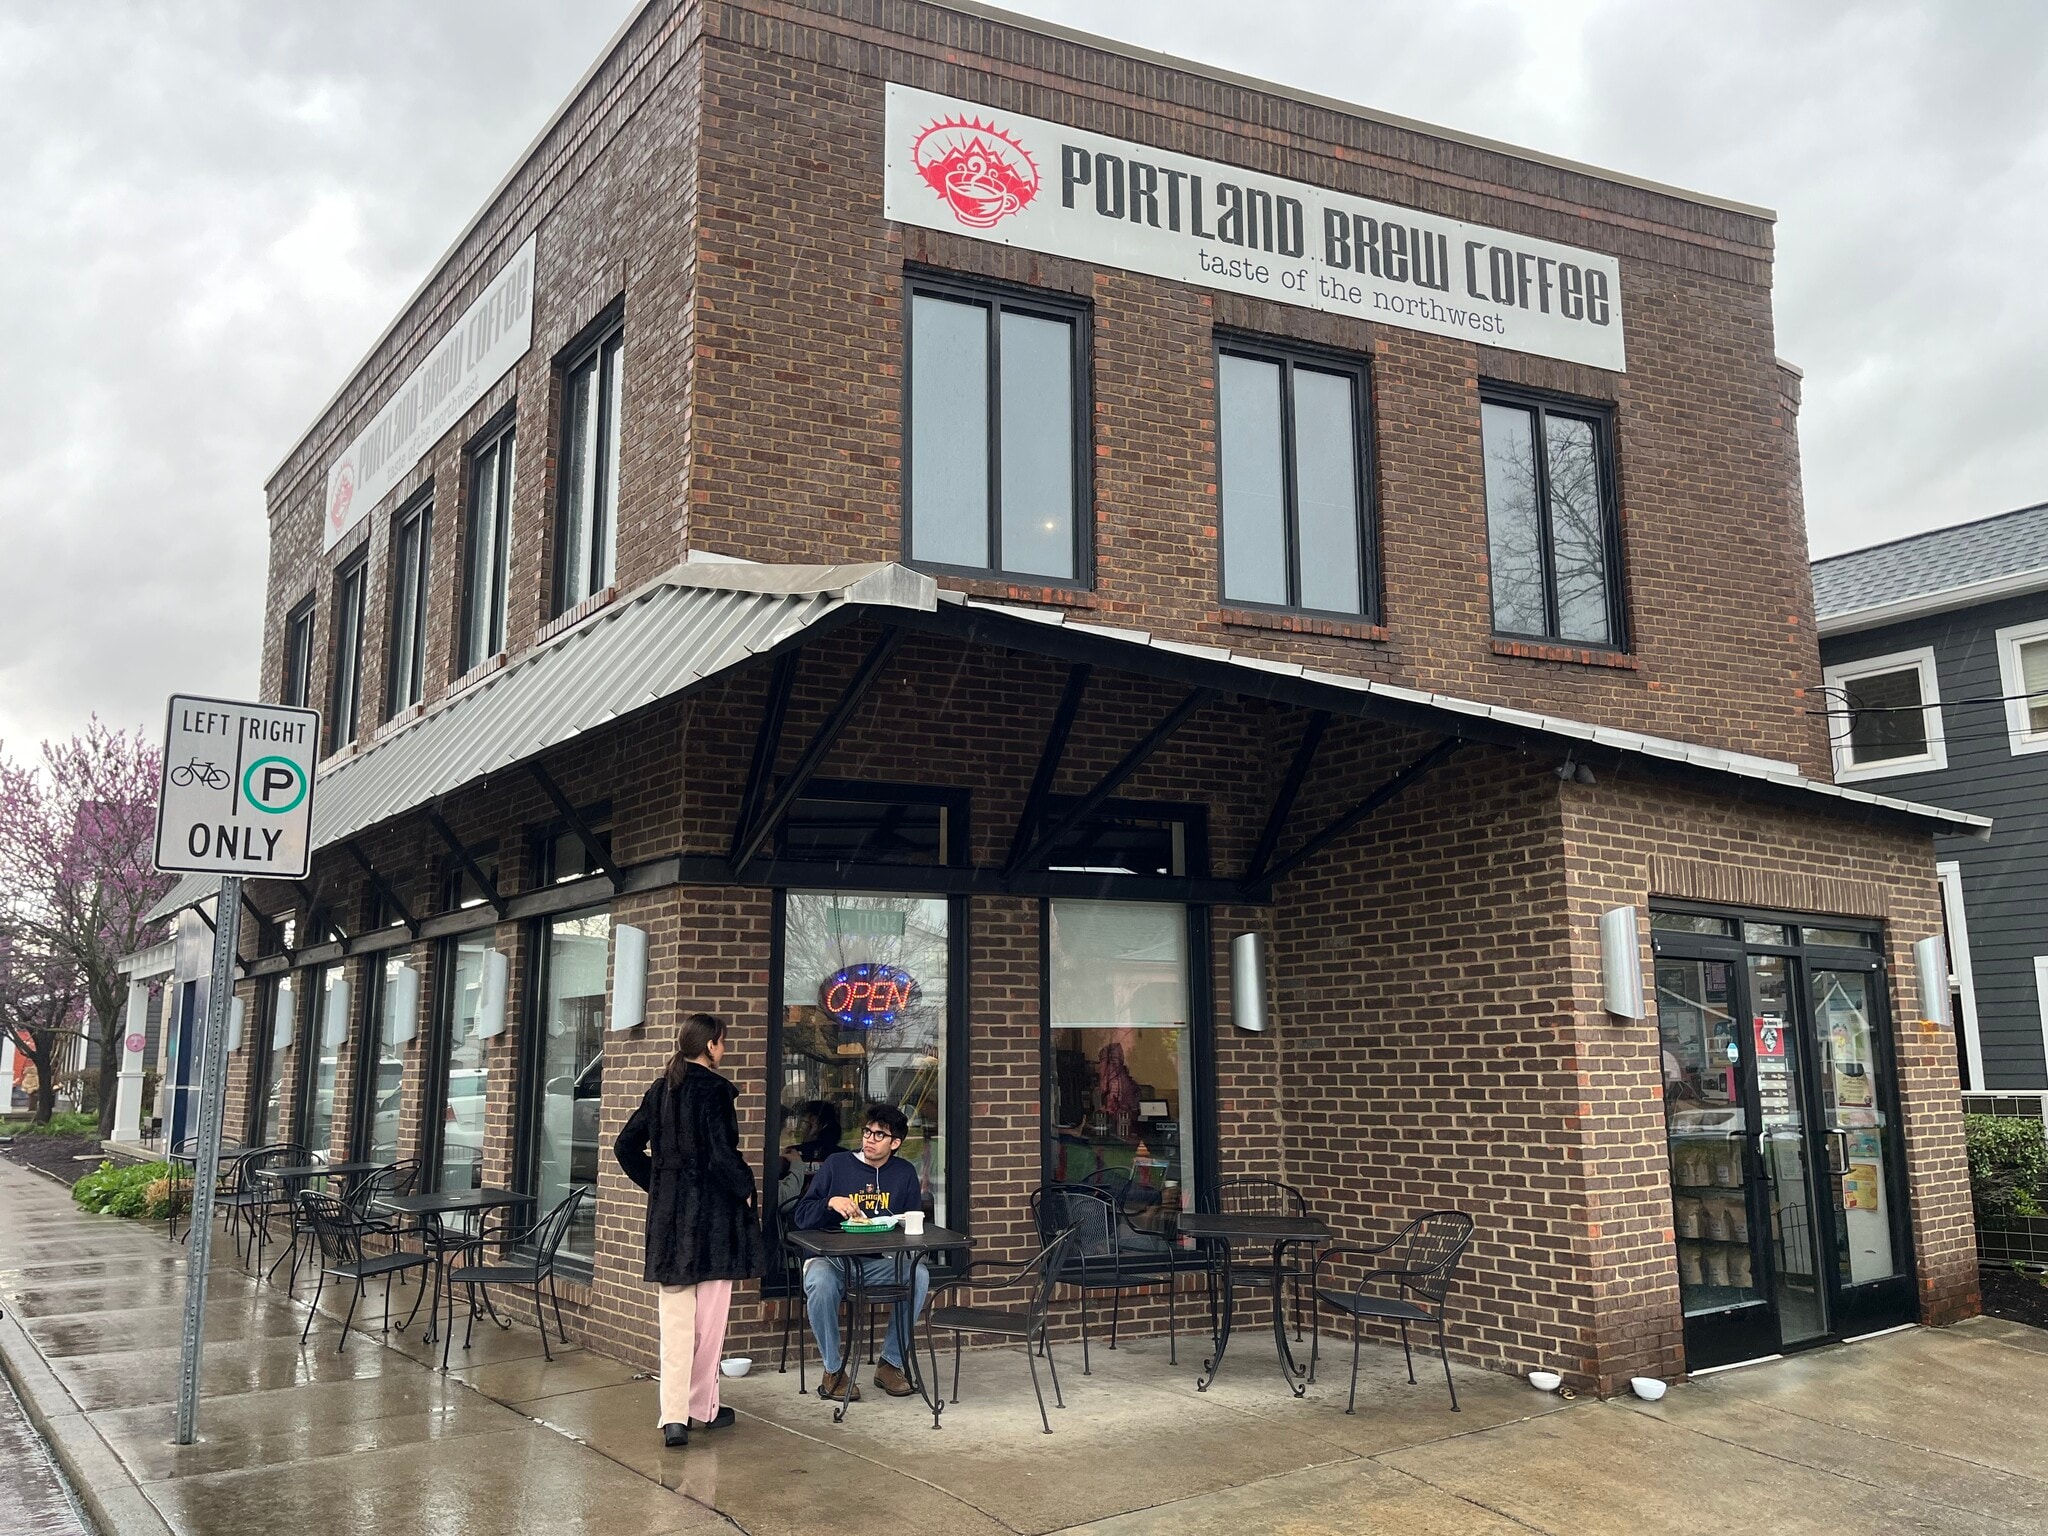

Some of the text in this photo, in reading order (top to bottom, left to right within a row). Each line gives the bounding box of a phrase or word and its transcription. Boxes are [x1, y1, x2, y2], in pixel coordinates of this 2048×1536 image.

[1198, 248, 1505, 335] taste of the northwest
[387, 455, 406, 483] taste
[431, 374, 479, 436] northwest
[182, 709, 307, 744] LEFT RIGHT
[262, 767, 295, 802] P
[188, 822, 283, 862] ONLY
[826, 981, 912, 1013] OPEN
[848, 1192, 890, 1210] MICHIGAN
